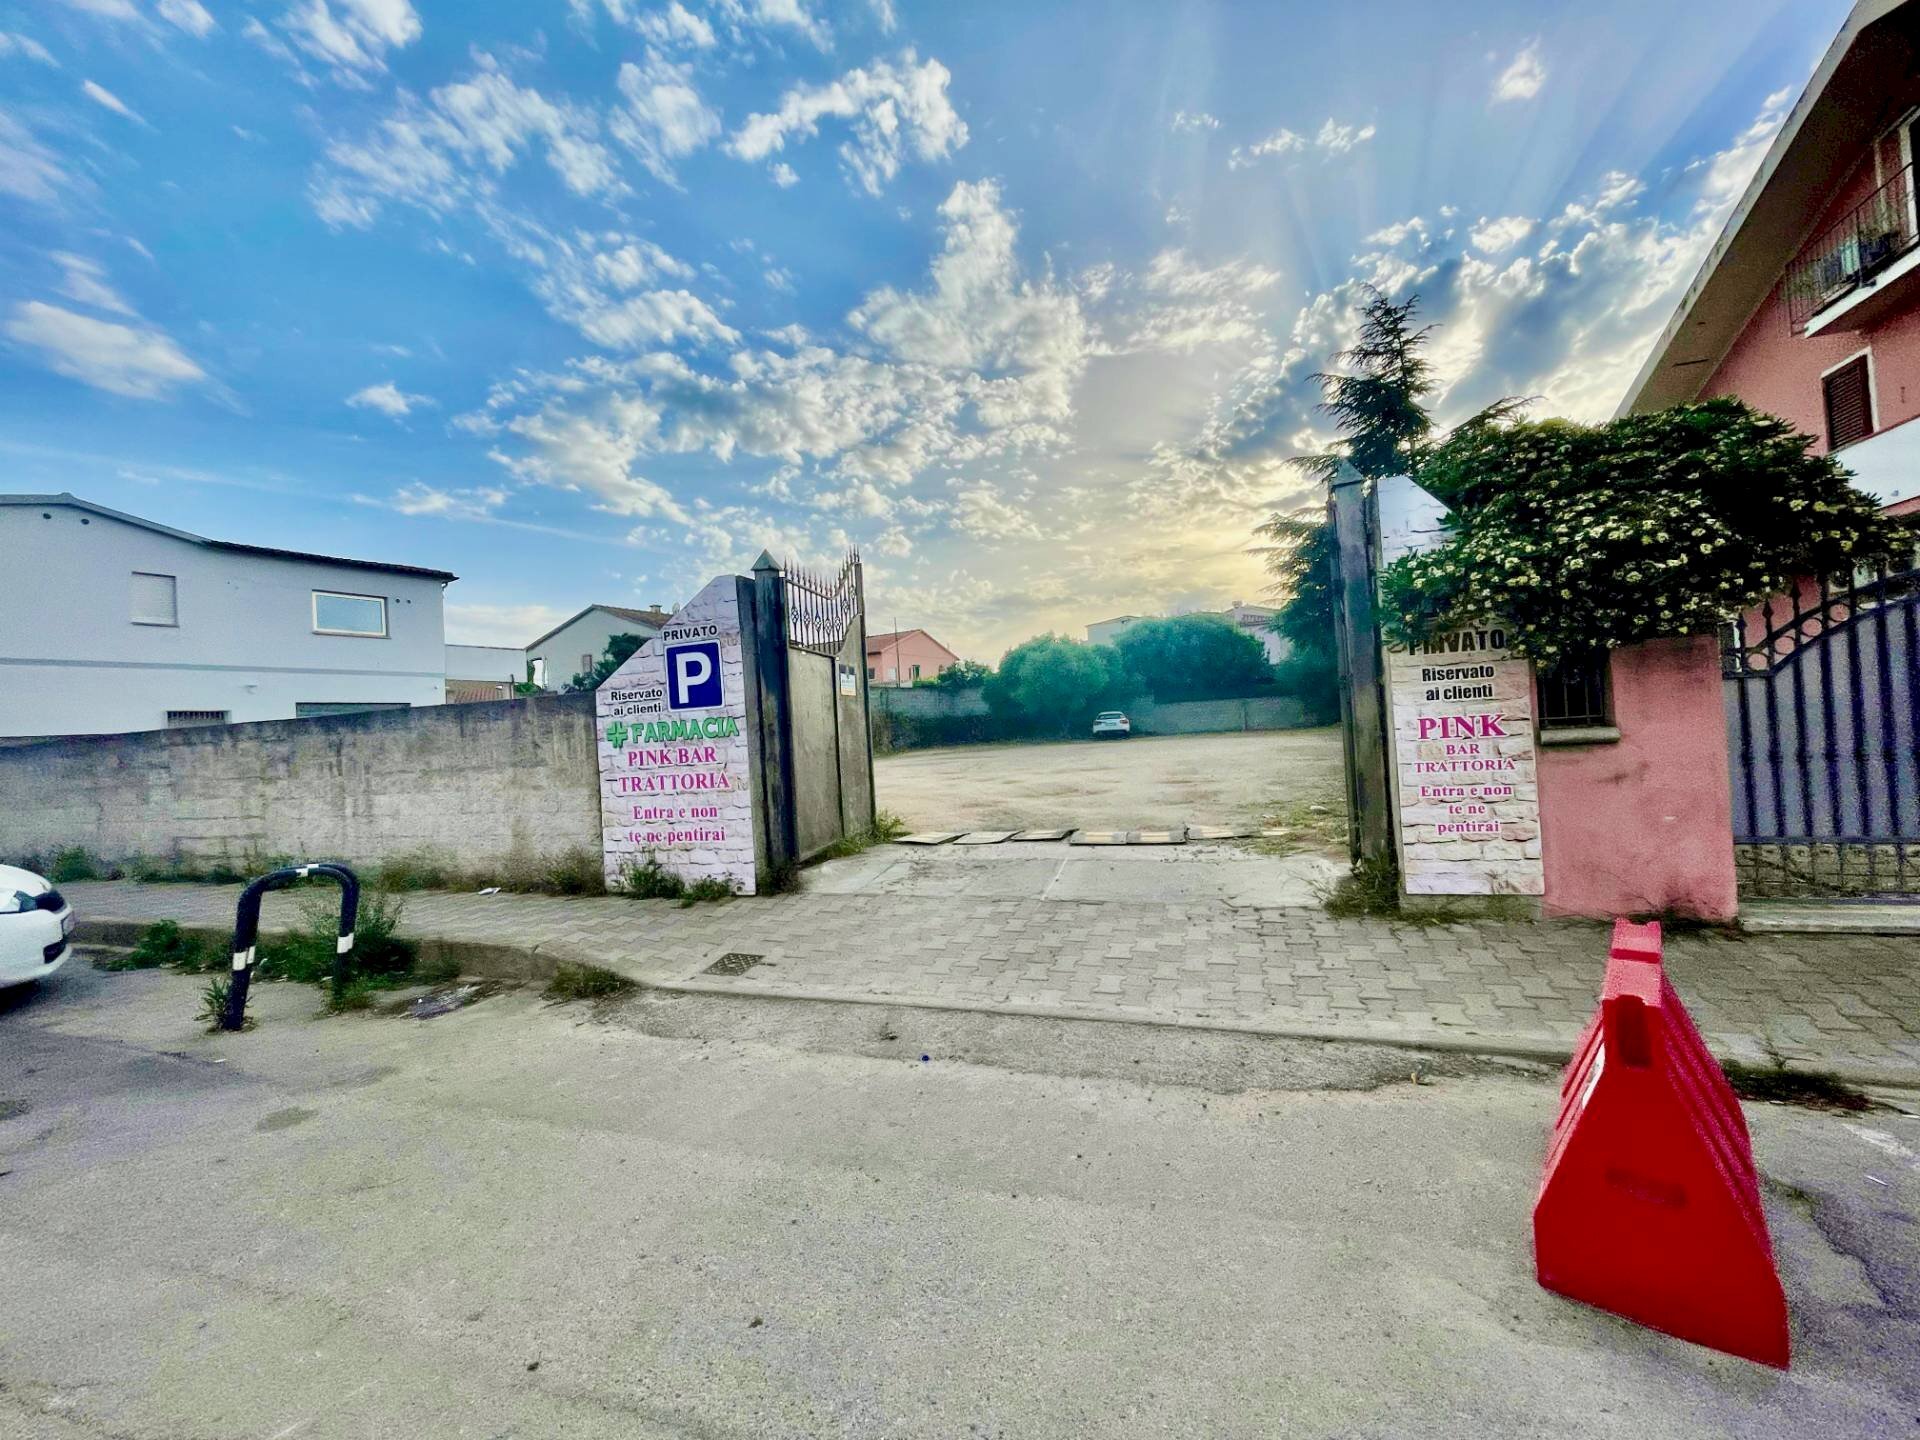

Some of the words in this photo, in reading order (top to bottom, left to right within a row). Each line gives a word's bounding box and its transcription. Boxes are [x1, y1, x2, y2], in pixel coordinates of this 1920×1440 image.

[663, 625, 718, 641] PRIVATO
[675, 652, 712, 704] P
[1422, 665, 1495, 682] Riservato
[611, 688, 663, 701] Riservato
[1426, 687, 1439, 700] ai
[1443, 684, 1493, 700] clienti
[613, 706, 624, 715] ai
[627, 703, 661, 714] clienti
[631, 717, 739, 743] FARMACIA
[1417, 713, 1507, 740] PINK
[628, 749, 673, 766] PINK
[678, 746, 717, 764] BAR
[1446, 744, 1480, 755] BAR
[1415, 759, 1515, 773] TRATTORIA
[618, 772, 730, 792] TRATTORIA
[1421, 786, 1465, 797] Entra
[1470, 787, 1478, 796] e
[1484, 786, 1512, 795] non
[633, 806, 674, 819] Entra
[678, 808, 686, 818] e
[691, 806, 718, 818] non
[1449, 805, 1462, 814] te
[1468, 805, 1486, 815] ne
[1437, 821, 1499, 834] pentirai
[629, 831, 641, 843] te
[646, 832, 663, 842] ne
[667, 827, 726, 845] pentirai
